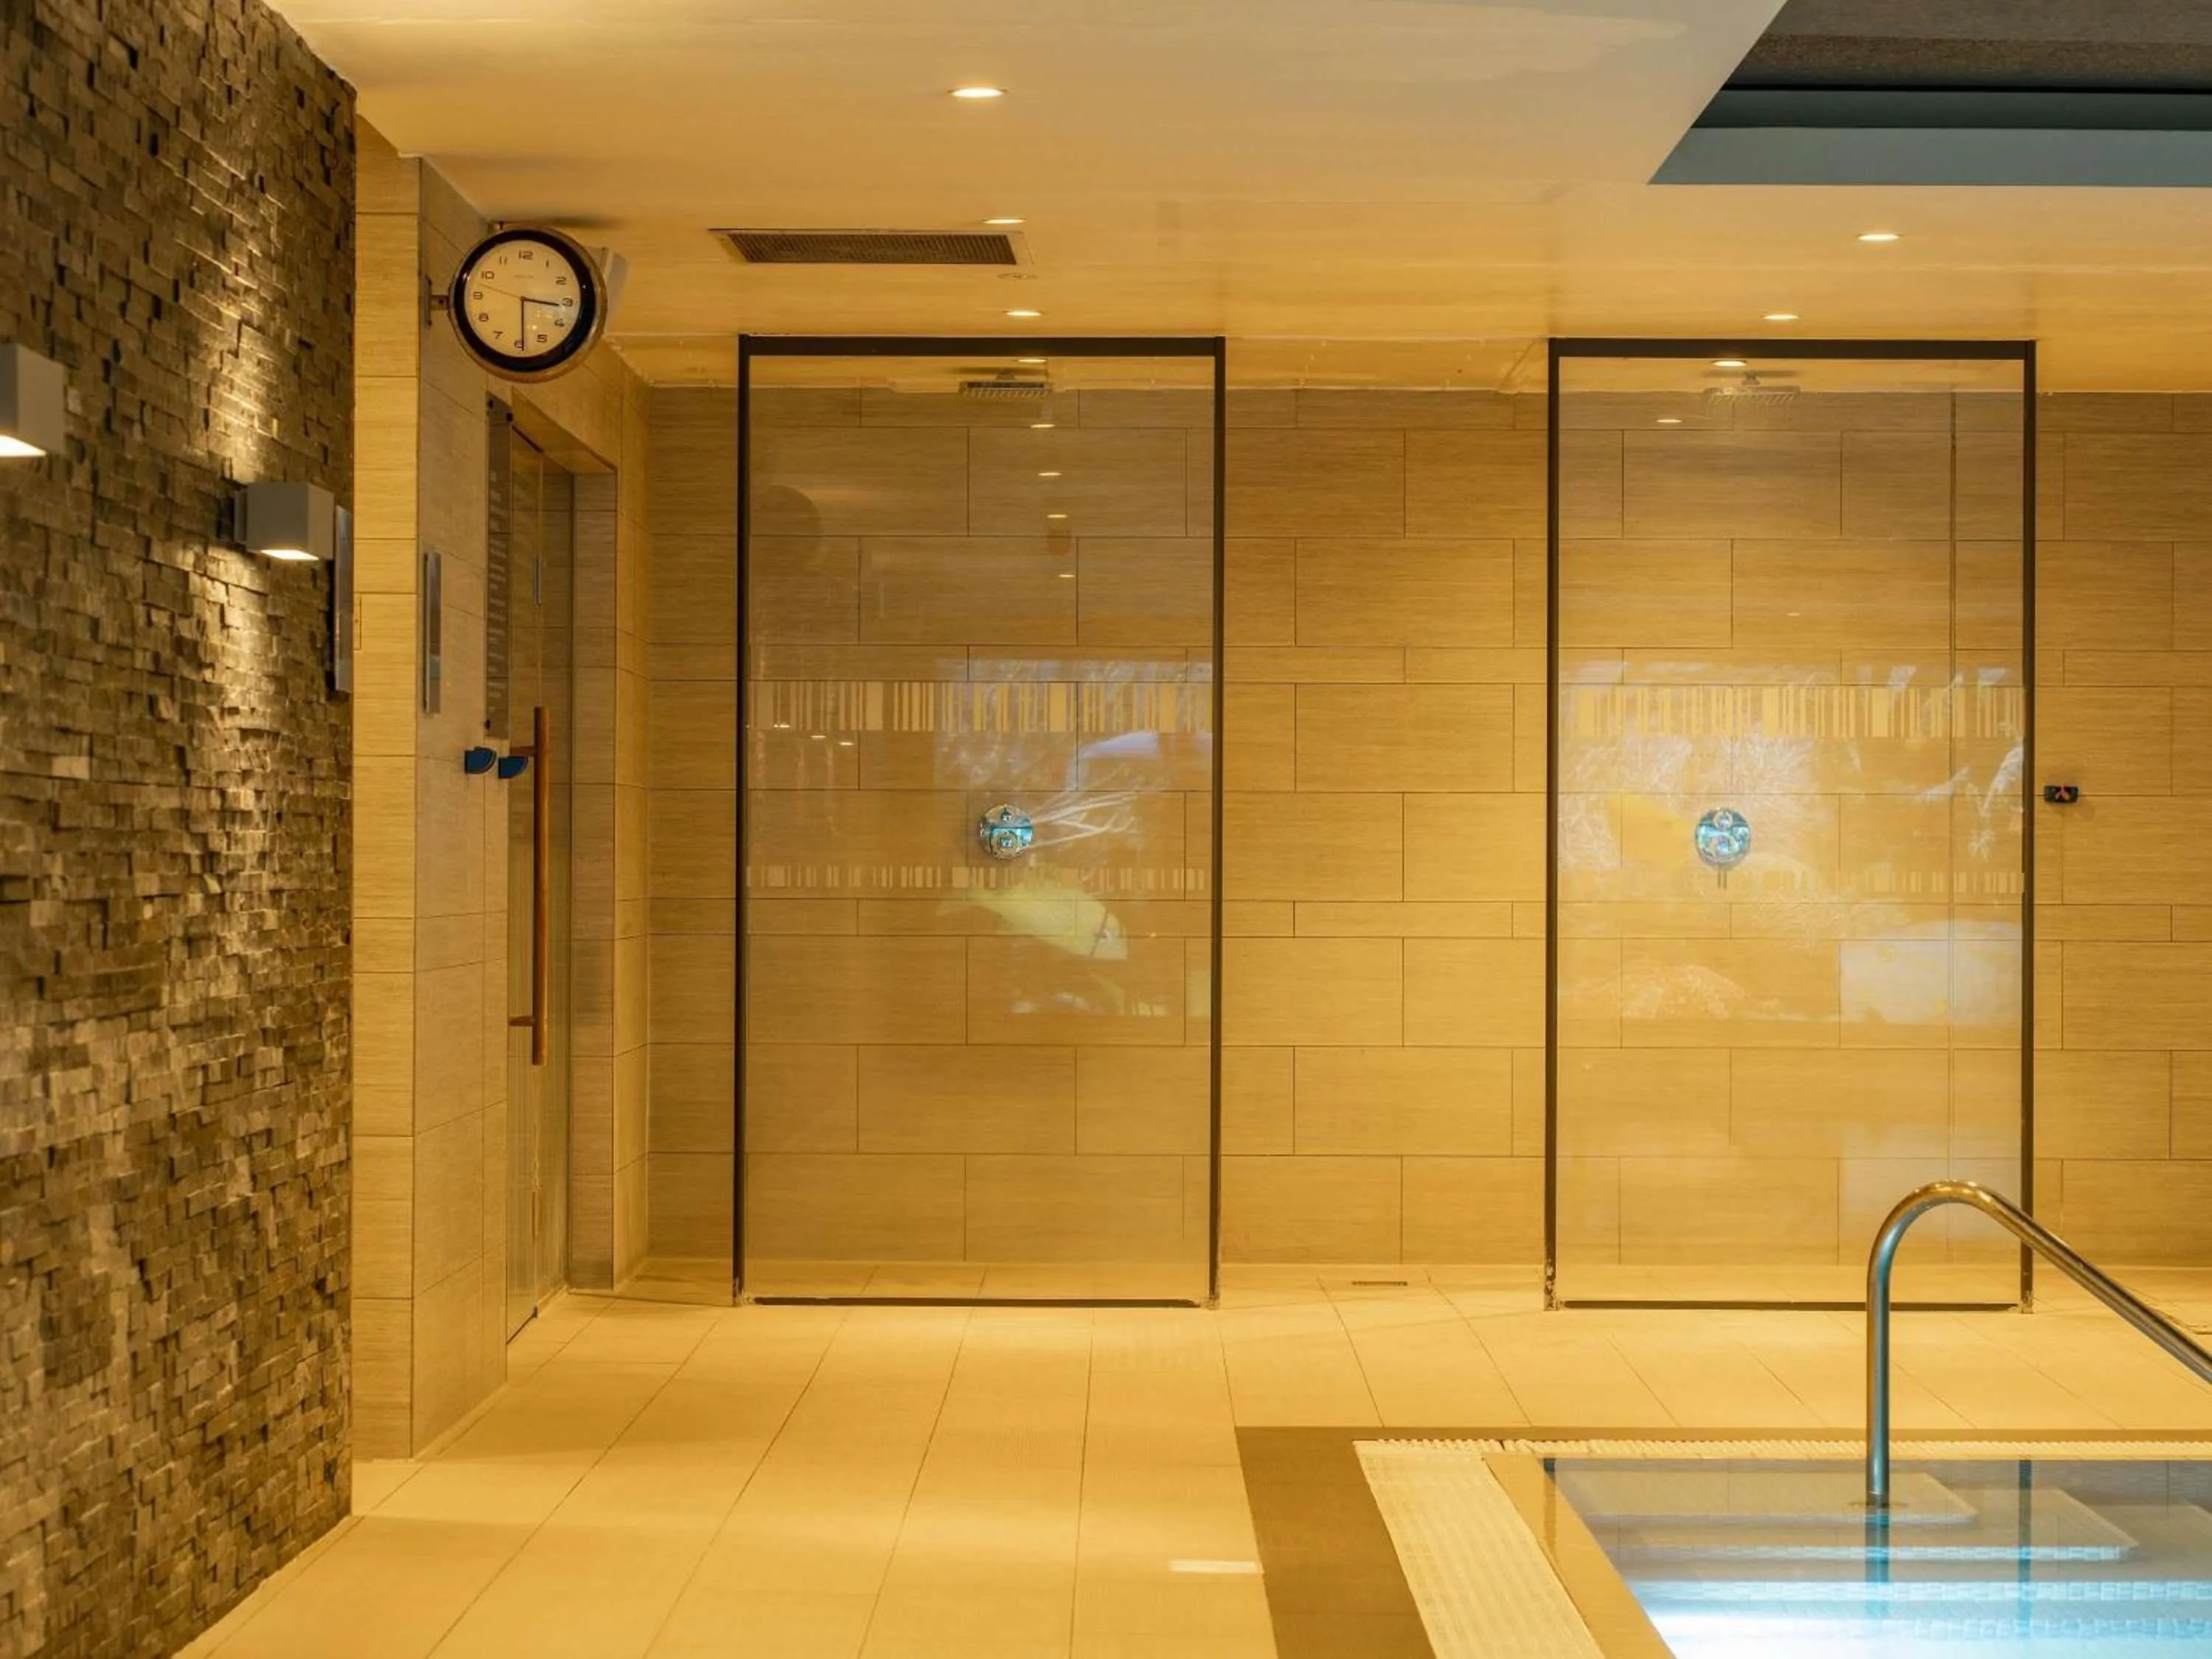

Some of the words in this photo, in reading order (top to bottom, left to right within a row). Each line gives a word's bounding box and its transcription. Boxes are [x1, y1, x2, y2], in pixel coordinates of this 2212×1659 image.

[519, 251, 533, 260] 12
[499, 257, 507, 265] 11
[481, 271, 495, 279] 10
[556, 276, 567, 285] 2
[562, 298, 573, 307] 3
[554, 319, 565, 327] 4
[493, 330, 503, 338] 7
[538, 334, 548, 343] 5
